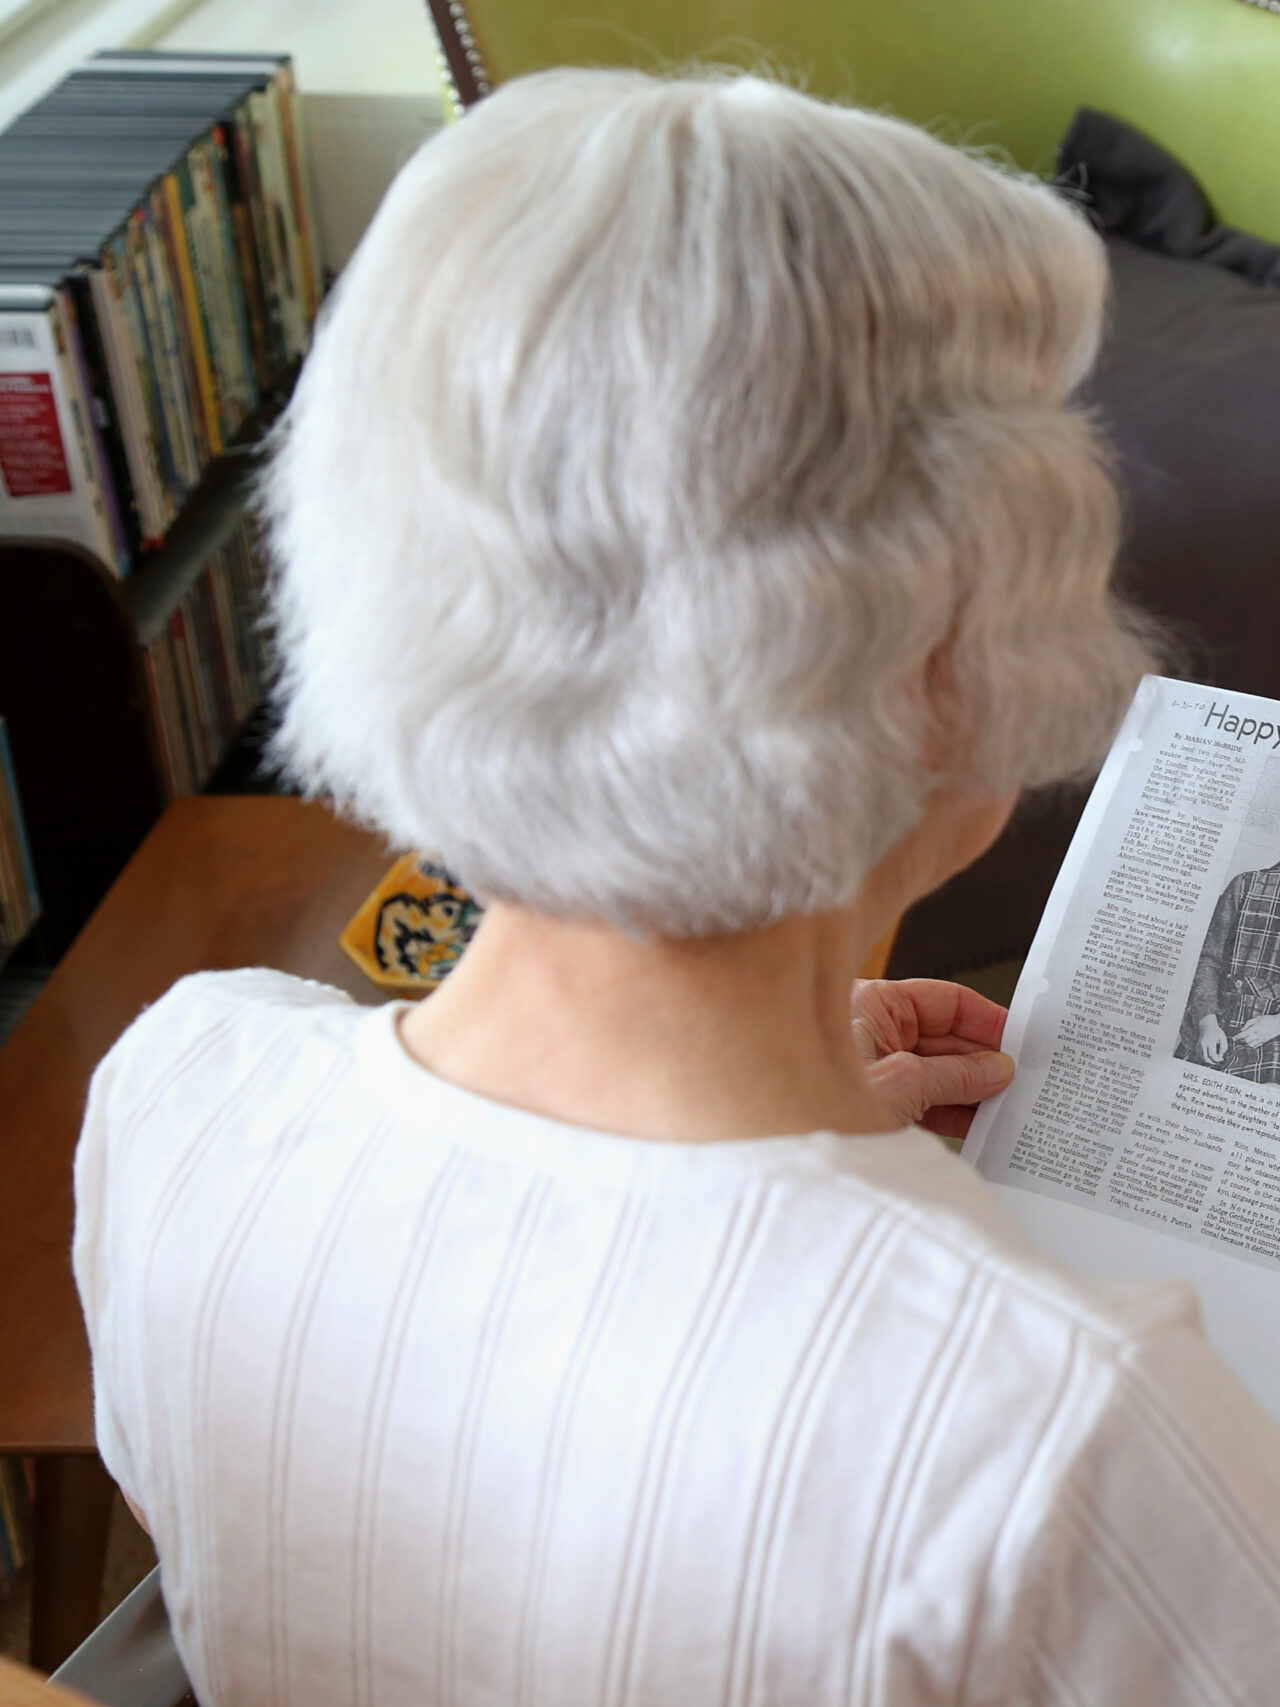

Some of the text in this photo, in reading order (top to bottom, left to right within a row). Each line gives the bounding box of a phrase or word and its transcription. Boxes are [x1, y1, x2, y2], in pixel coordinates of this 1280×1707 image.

[1173, 731, 1242, 753] By MARIAN McBRIDE
[1117, 851, 1144, 863] Abortion
[1145, 858, 1161, 867] three
[1160, 864, 1179, 873] years
[1136, 848, 1169, 862] Committee
[1181, 860, 1208, 872] Legalize
[1110, 869, 1199, 899] organization was hearing
[1127, 865, 1150, 876] natural
[1150, 872, 1182, 885] outgrowth
[1178, 1083, 1200, 1094] against
[1230, 1097, 1236, 1105] is
[1237, 1100, 1247, 1108] the
[1247, 1105, 1270, 1115] mother
[1270, 1110, 1279, 1118] of
[1201, 1077, 1223, 1090] EDITH
[1244, 1092, 1257, 1101] who
[1266, 1097, 1273, 1105] in
[1170, 1101, 1181, 1110] the
[1180, 1106, 1196, 1115] right
[1204, 1112, 1225, 1124] decide
[1226, 1118, 1240, 1128] their
[1190, 1095, 1204, 1106] Rein
[1206, 1103, 1223, 1112] wants
[1225, 1106, 1236, 1115] her
[1237, 1111, 1267, 1126] daughters
[1229, 1151, 1242, 1159] all
[1244, 1155, 1264, 1166] places
[1170, 1216, 1192, 1229] Puerto
[1208, 1204, 1228, 1216] Judge
[1228, 1211, 1254, 1225] Gerhard
